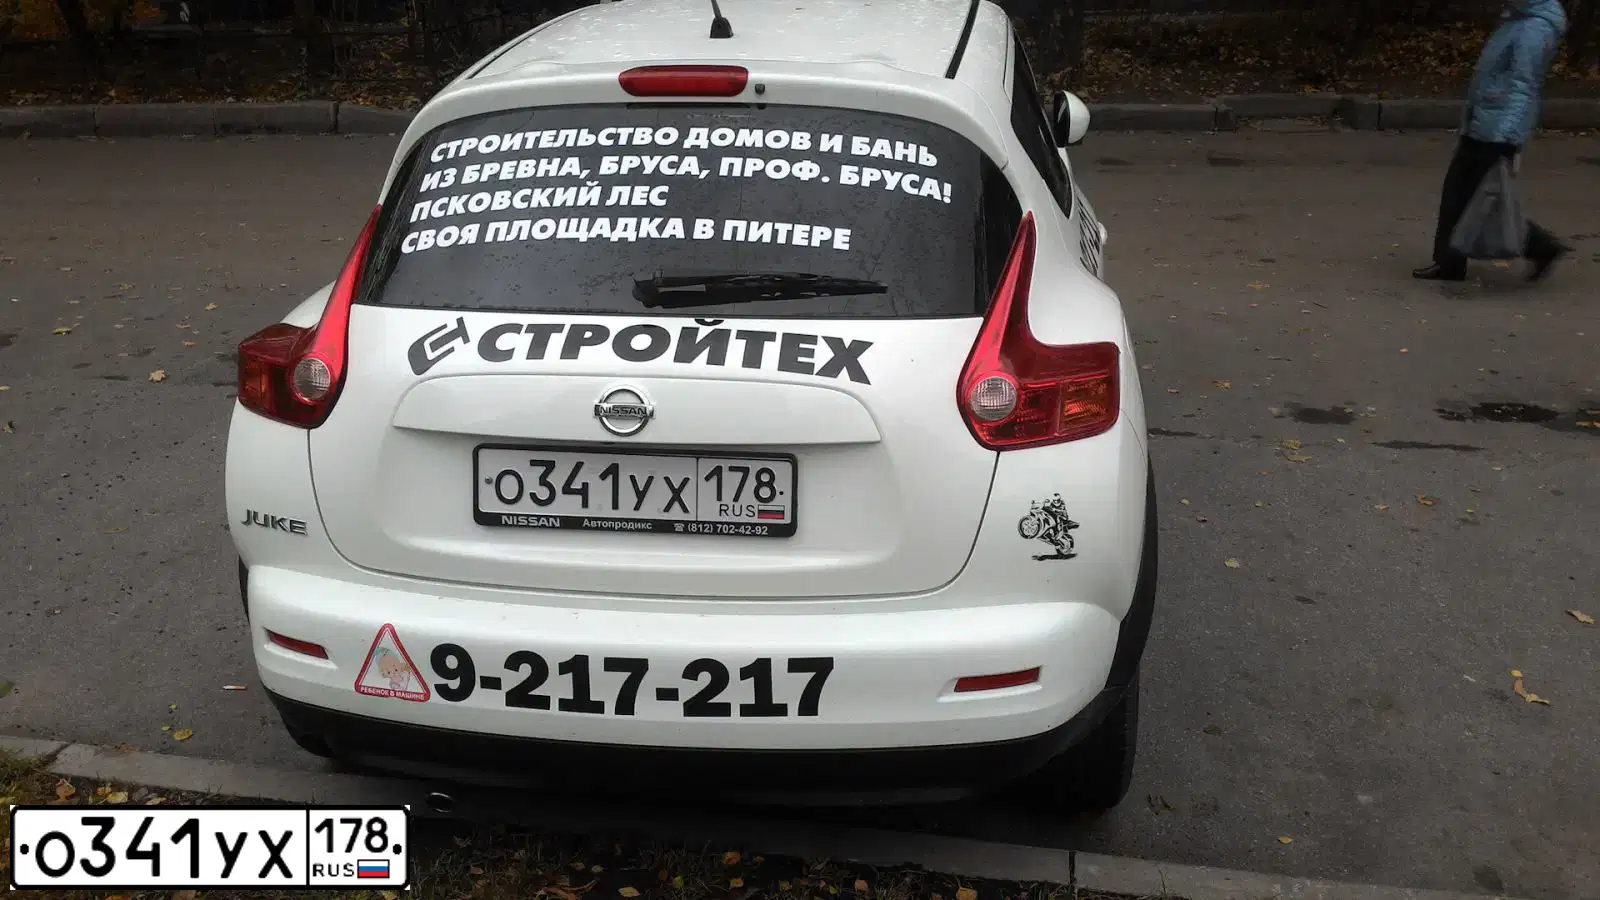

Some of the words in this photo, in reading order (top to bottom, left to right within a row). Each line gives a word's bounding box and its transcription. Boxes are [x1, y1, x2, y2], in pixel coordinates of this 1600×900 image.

[430, 127, 679, 163] СТРОИТЕЛЬСТВО
[683, 127, 812, 152] ДОМОВ
[818, 135, 843, 154] И
[851, 137, 938, 167] БАНЬ
[420, 168, 458, 193] ИЗ
[461, 156, 591, 184] БРЕВНА,
[599, 155, 711, 178] БРУСА,
[718, 157, 831, 182] ПРОФ.
[839, 164, 953, 203] БРУСА!
[409, 181, 601, 223] ПСКОВСКИЙ
[605, 186, 668, 207] ЛЕС
[401, 223, 480, 255] СВОЯ
[484, 218, 685, 243] ПЛОЩАДКА
[693, 219, 715, 239] В
[721, 220, 852, 251] ПИТЕРЕ
[477, 319, 873, 385] СТРОЙТЕХ
[599, 405, 647, 416] NISSAN
[703, 465, 777, 503] 178
[241, 508, 308, 535] JUKE
[501, 515, 560, 527] NISSAN
[582, 518, 653, 531] Автопродикс
[688, 522, 713, 533] (812)
[716, 524, 768, 536] 702-42-92
[719, 504, 756, 518] RUS
[430, 643, 835, 717] 9-217-217
